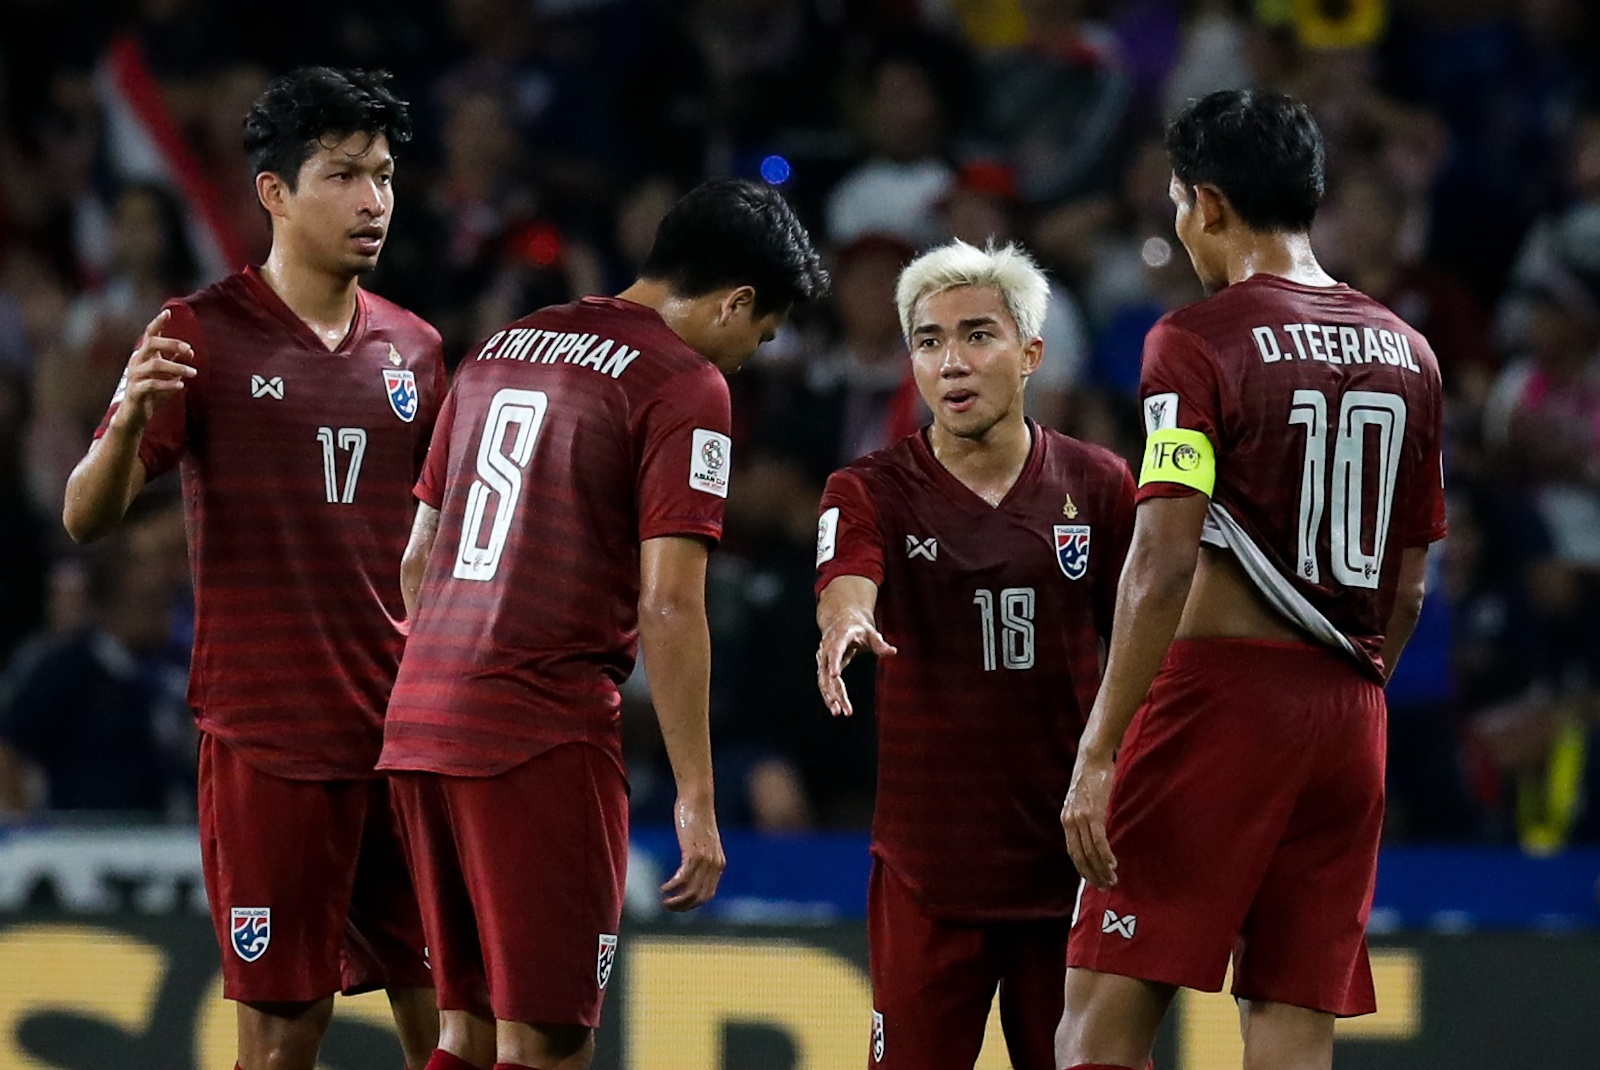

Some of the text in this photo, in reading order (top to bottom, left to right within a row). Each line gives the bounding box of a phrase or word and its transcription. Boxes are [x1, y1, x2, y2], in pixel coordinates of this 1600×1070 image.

[477, 328, 640, 379] P.THITIPHAN
[1252, 324, 1421, 374] D.TEERASIL
[316, 427, 367, 504] 17
[452, 388, 548, 582] 8
[1288, 389, 1407, 589] 10
[973, 587, 1036, 671] 18
